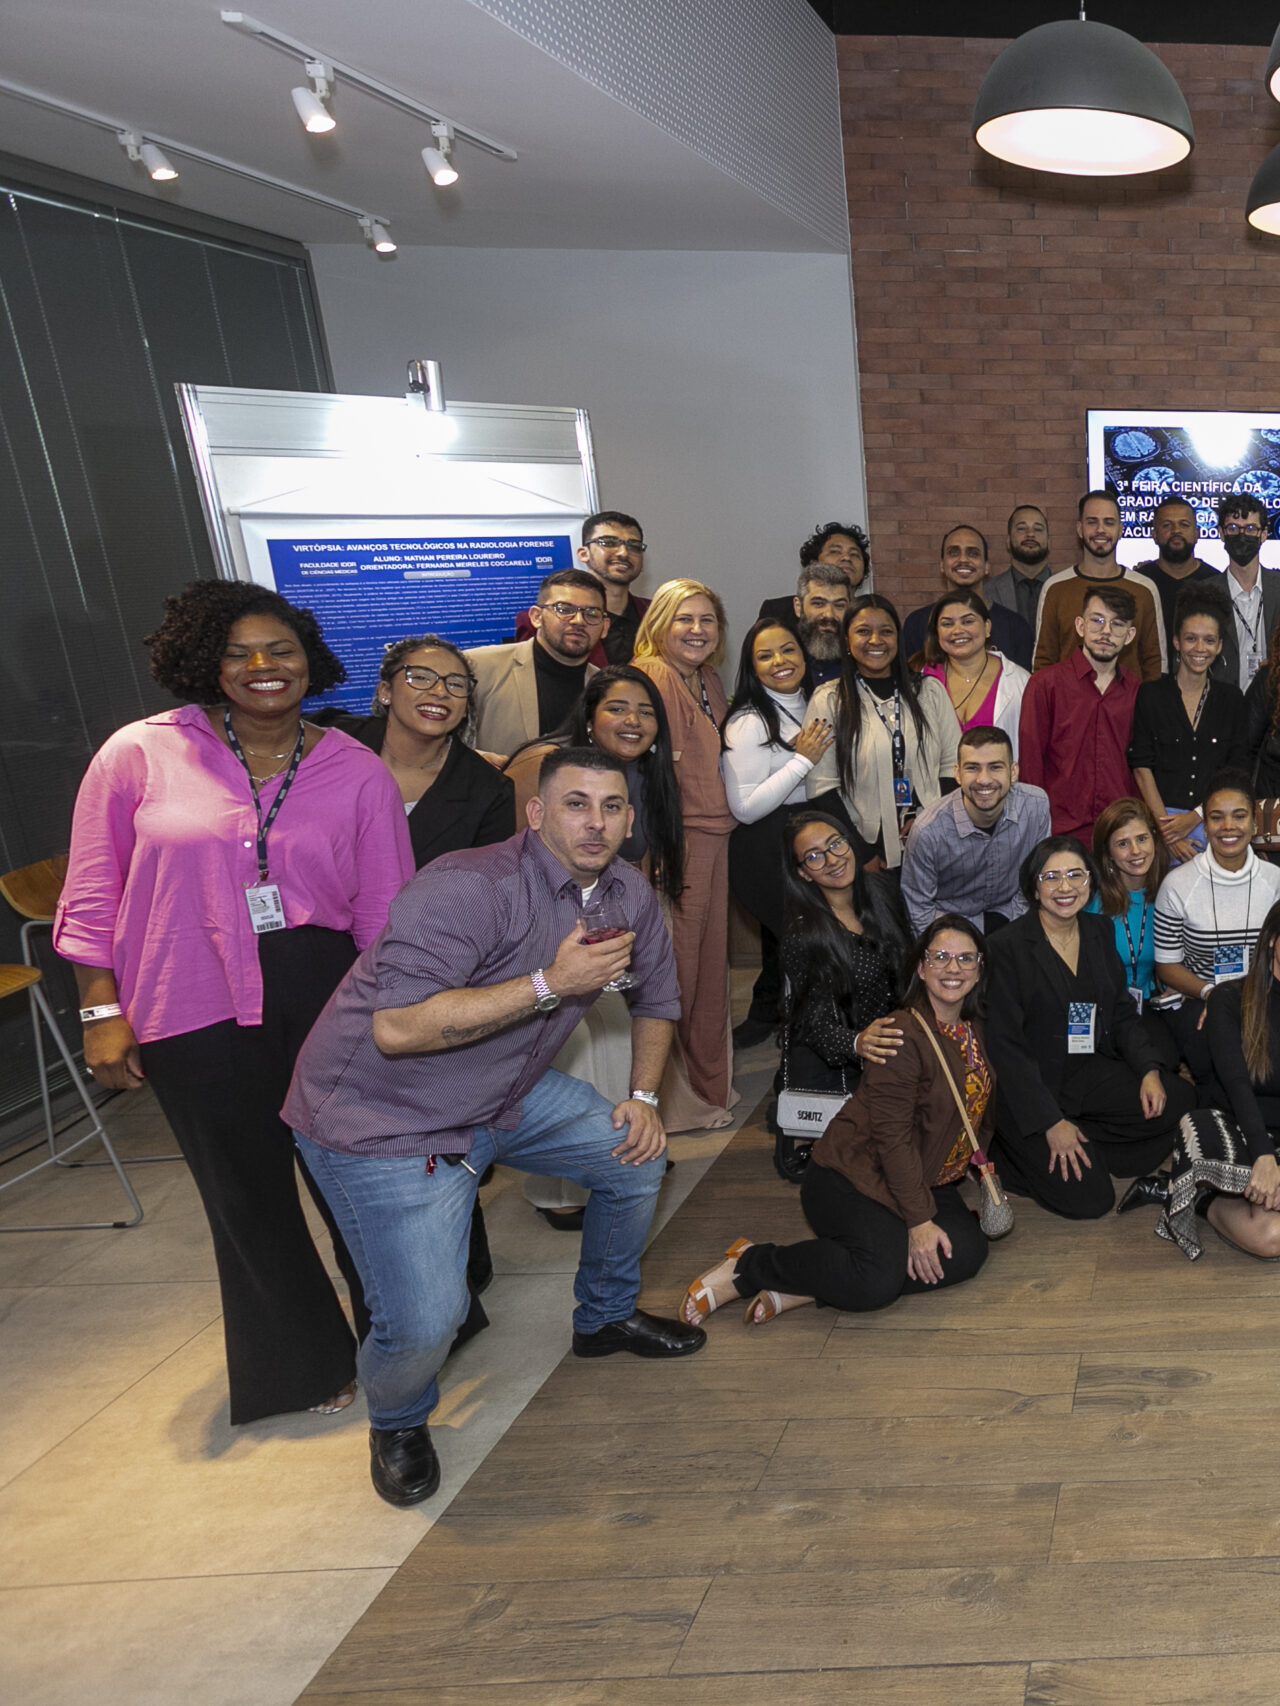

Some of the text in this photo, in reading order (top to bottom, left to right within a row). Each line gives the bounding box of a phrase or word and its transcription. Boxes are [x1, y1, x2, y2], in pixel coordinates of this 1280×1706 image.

[1116, 480, 1262, 493] 3ª FEIRA CIENTÍFICA DA
[1117, 495, 1199, 508] GRADUO
[1201, 497, 1219, 508] DE
[1119, 511, 1136, 522] EM
[292, 543, 345, 552] VIRTÓPSIA:
[346, 543, 388, 552] AVANÇOS
[389, 541, 455, 551] TECNOLÓGICOS
[469, 541, 518, 549] RADIOLOGIA
[519, 540, 555, 548] FORENSE
[360, 563, 415, 571] ORIENTADORA:
[797, 1110, 822, 1122] SCHUTZ
